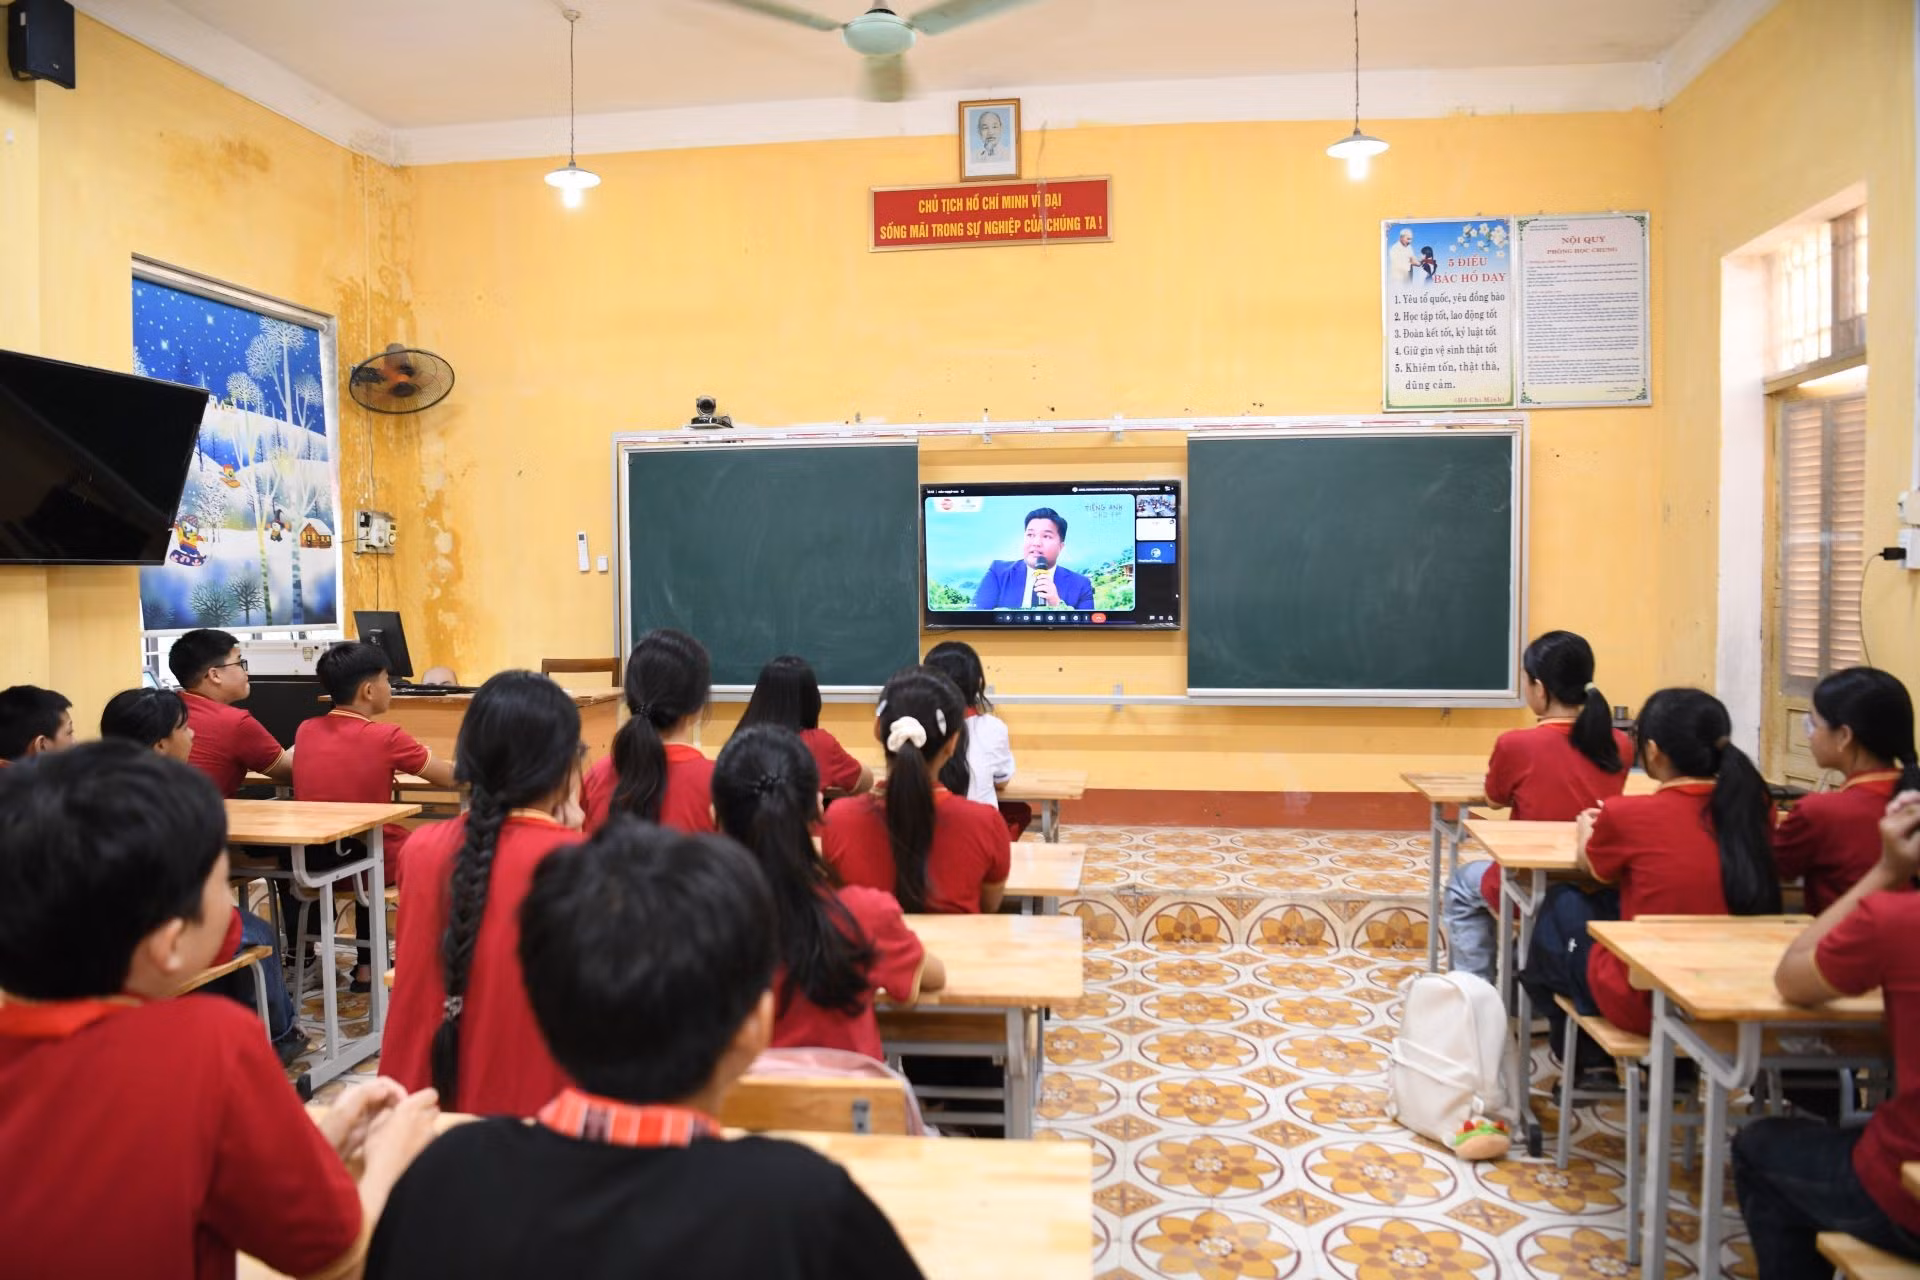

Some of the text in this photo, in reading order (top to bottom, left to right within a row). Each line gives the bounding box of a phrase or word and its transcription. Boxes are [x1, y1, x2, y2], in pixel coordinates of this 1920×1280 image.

[918, 194, 938, 213] CHỦ
[941, 198, 963, 214] TỊCH
[982, 193, 999, 210] CHÍ
[1002, 194, 1028, 209] MINH
[1044, 192, 1062, 209] ĐẠI
[880, 221, 907, 239] SỐNG
[910, 221, 929, 238] MÃI
[931, 222, 963, 237] TRONG
[967, 220, 981, 238] SỰ
[984, 217, 1021, 236] NGHIỆP
[1046, 214, 1080, 232] CHÚNG
[1084, 215, 1096, 230] TA
[1448, 259, 1455, 267] 5
[1434, 272, 1458, 284] BÁC
[1482, 272, 1506, 284] DẠY
[1403, 294, 1418, 304] Yêu
[1430, 292, 1451, 305] quốc,
[1453, 293, 1467, 305] yêu
[1403, 311, 1419, 323] Học
[1420, 311, 1433, 323] tập
[1435, 309, 1449, 321] tốt,
[1451, 310, 1463, 319] lao
[1465, 310, 1484, 321] động
[1486, 308, 1497, 319] tốt
[1403, 328, 1424, 338] Đoàn
[1426, 326, 1438, 337] kết
[1441, 326, 1454, 338] tốt,
[1467, 327, 1483, 339] luật
[1485, 325, 1496, 336] tốt
[1403, 345, 1419, 356] Giữ
[1447, 344, 1464, 354] sinh
[1466, 344, 1483, 356] thật
[1485, 342, 1497, 353] tốt
[1394, 363, 1403, 373] 5.
[1405, 363, 1436, 373] Khiêm
[1438, 361, 1457, 373] tốn,
[1459, 361, 1478, 374] thật
[1405, 379, 1456, 391] dũng cảm.
